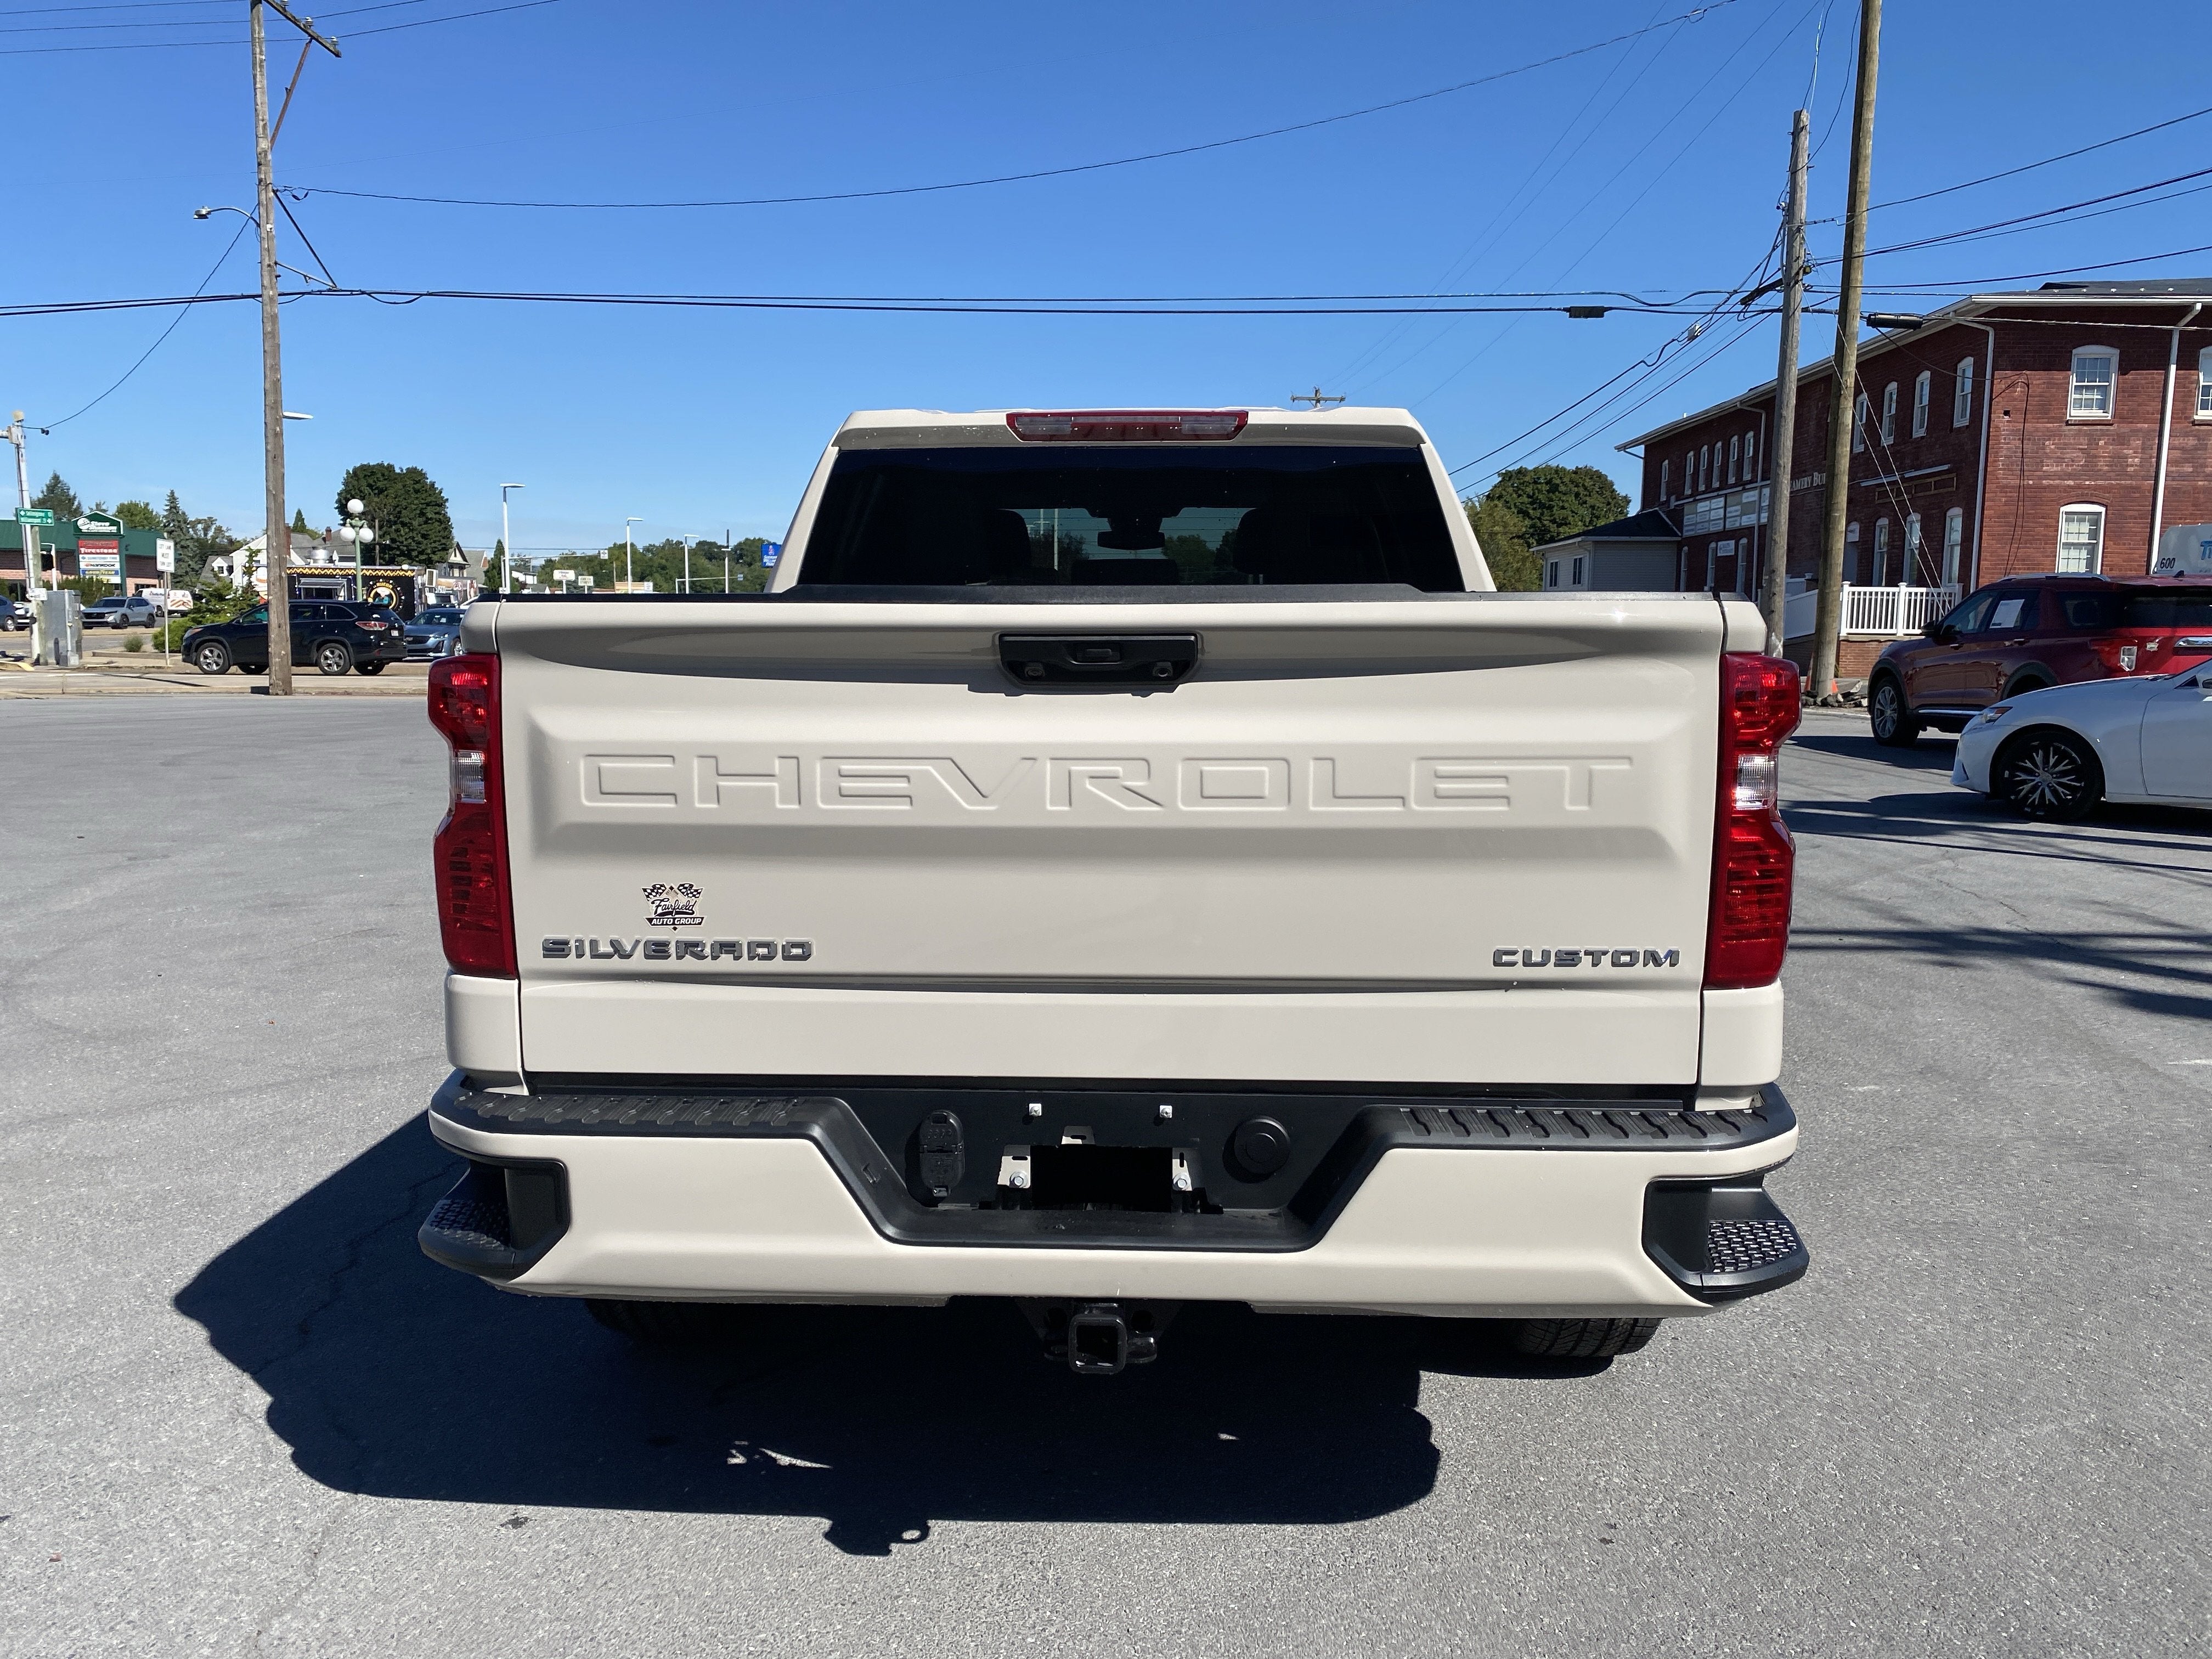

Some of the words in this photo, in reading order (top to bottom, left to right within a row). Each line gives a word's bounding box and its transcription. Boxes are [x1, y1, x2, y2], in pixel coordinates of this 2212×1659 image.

[2160, 557, 2176, 569] 600
[582, 754, 1633, 810] CHEVROLET
[650, 898, 697, 917] Fairfield
[541, 937, 814, 961] SILVERADO
[1493, 946, 1680, 968] CUSTOM
